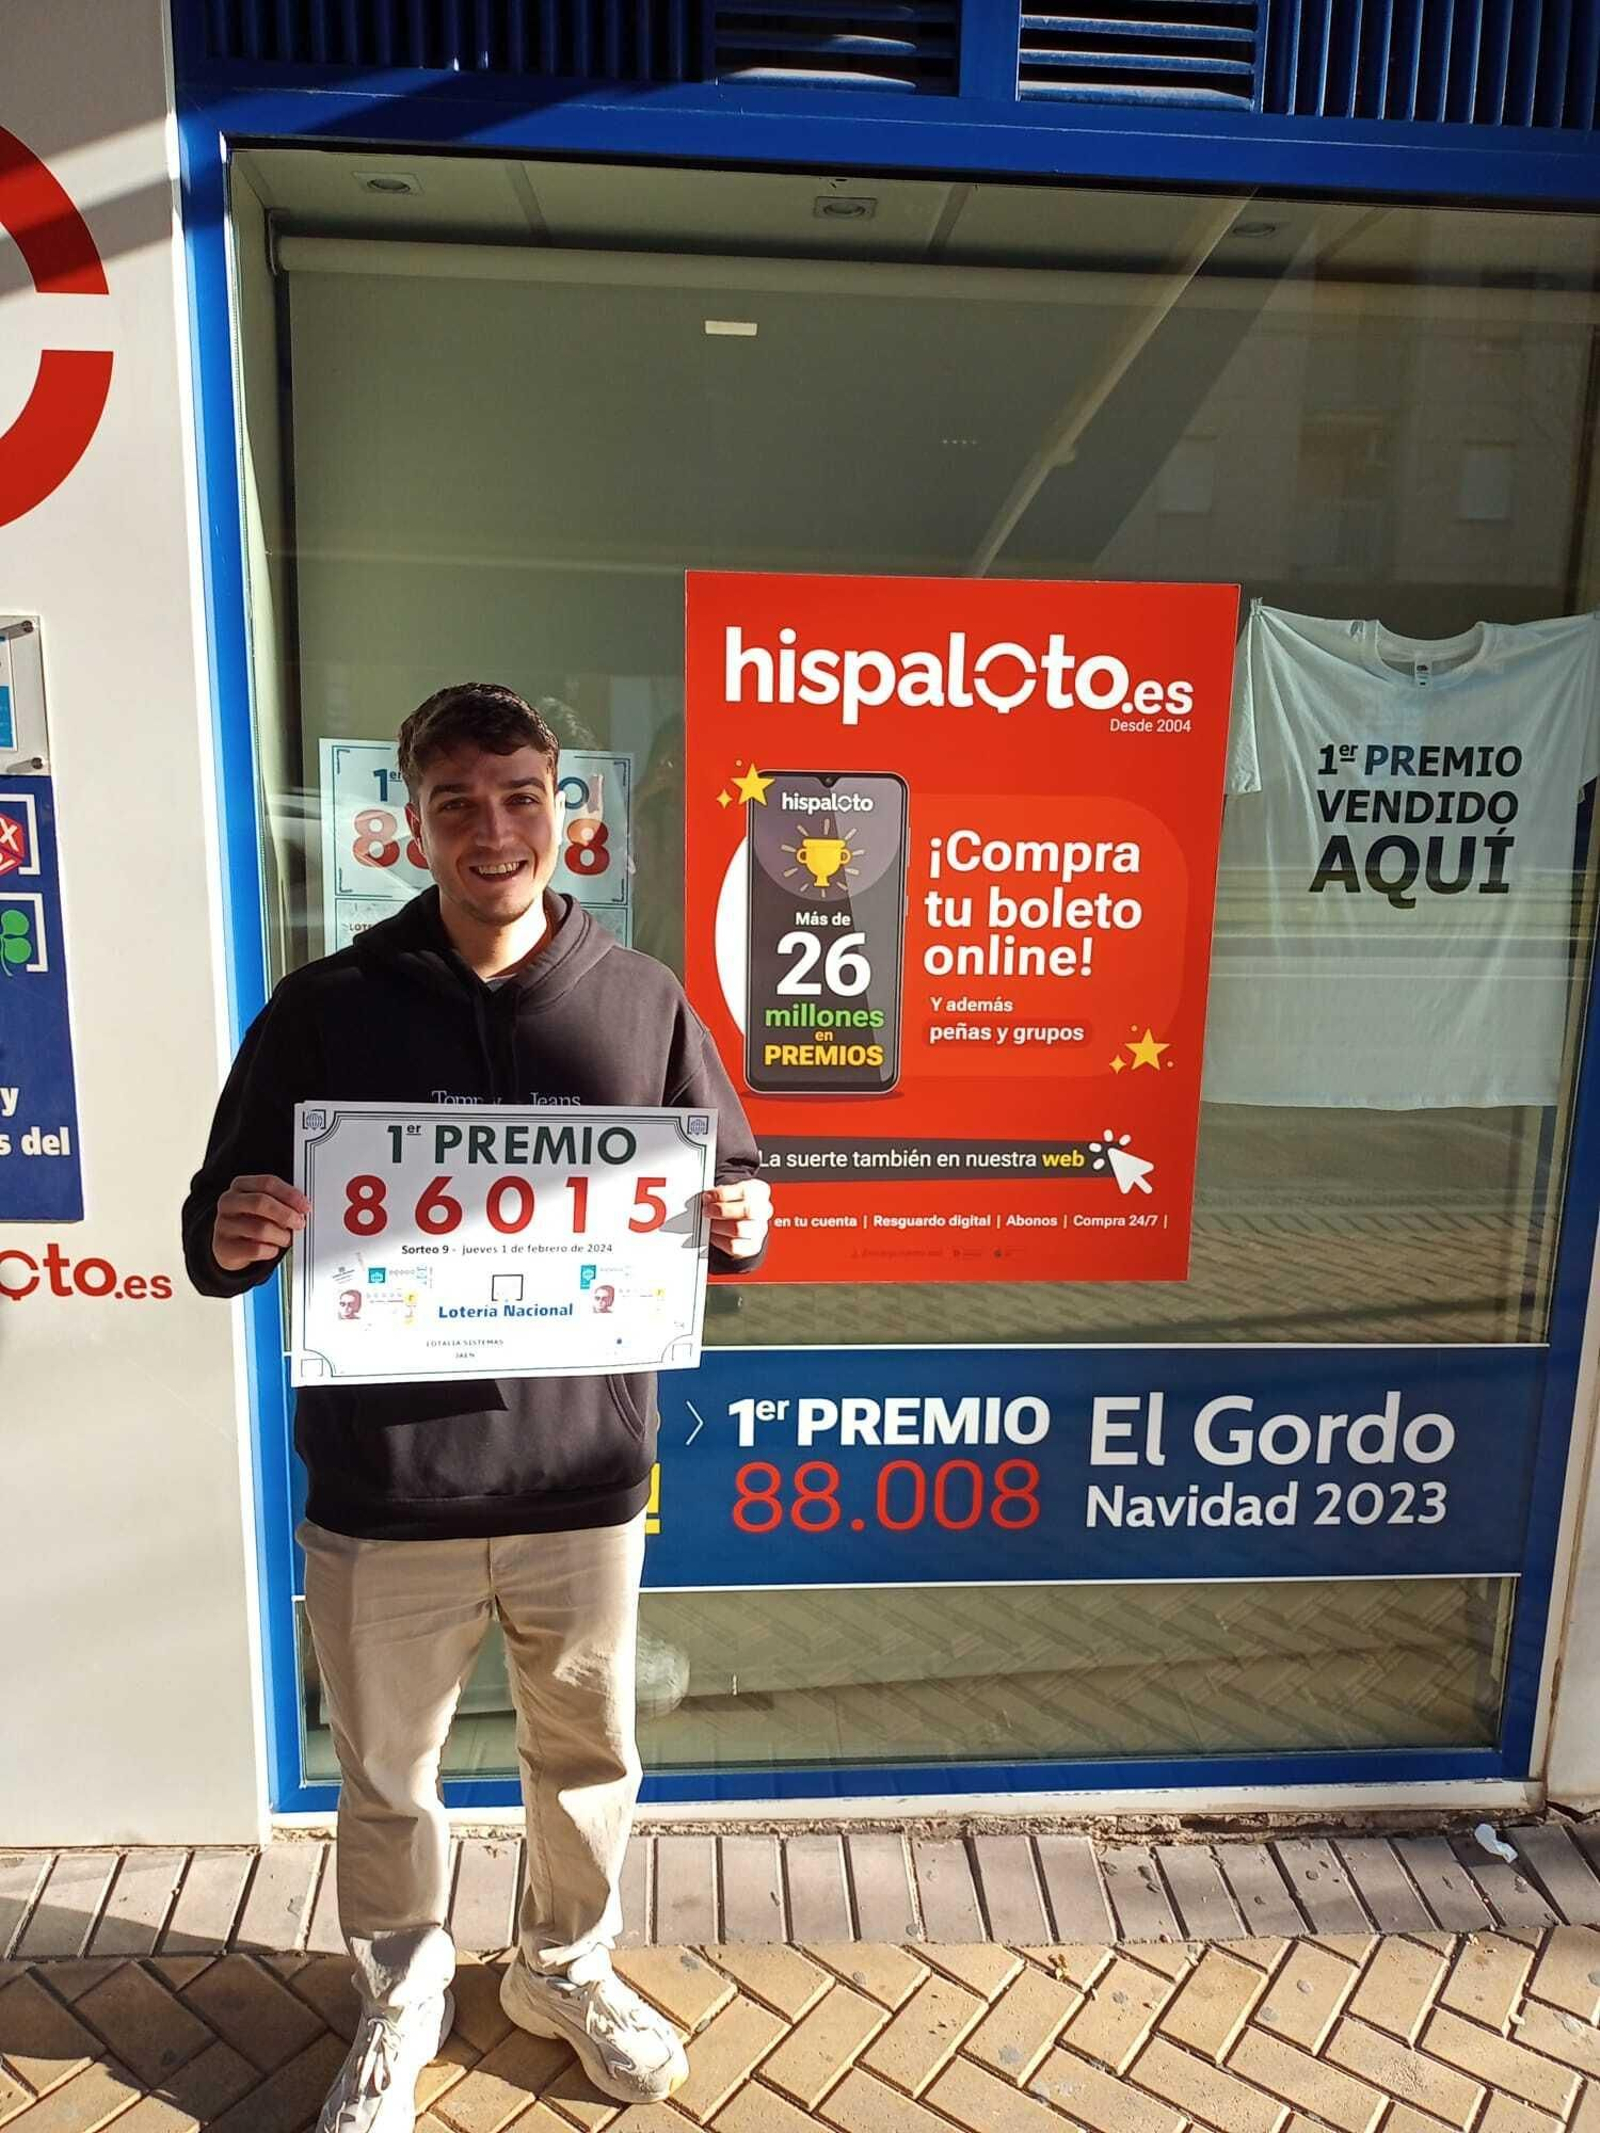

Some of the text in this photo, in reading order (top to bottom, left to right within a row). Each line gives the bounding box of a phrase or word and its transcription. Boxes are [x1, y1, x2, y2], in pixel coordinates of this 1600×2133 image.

[724, 626, 1194, 725] hispaloto.es
[1109, 718, 1191, 733] Desde 2004
[1317, 744, 1523, 777] 1er PREMIO
[781, 792, 873, 815] hispaloto
[1316, 789, 1519, 824] VENDIDO
[929, 829, 1141, 883] ¡Compra
[1308, 827, 1516, 910] AQUÍ
[795, 911, 851, 926] Más de
[924, 885, 1143, 929] tu boleto
[776, 930, 872, 998] 26
[923, 933, 1093, 977] online!
[765, 1003, 885, 1028] millones
[930, 996, 1014, 1012] Y además
[815, 1030, 833, 1042] en
[929, 1022, 1085, 1045] peñas y grupos
[764, 1044, 884, 1066] PREMIOS
[21, 1126, 71, 1156] del
[387, 1123, 637, 1165] 1er PREMIO
[759, 1149, 1085, 1168] La suerte también en nuestra web
[343, 1174, 668, 1236] 86015
[774, 1217, 790, 1227] en
[795, 1215, 808, 1227] tu
[811, 1215, 857, 1227] cuenta
[874, 1214, 946, 1229] Resguardo
[949, 1214, 991, 1229] digital
[1006, 1215, 1058, 1227] Abonos
[1073, 1215, 1126, 1228] Compra
[1129, 1215, 1158, 1227] 24/7
[401, 1245, 439, 1254] Sorteo
[442, 1245, 449, 1254] 9
[462, 1245, 498, 1256] jueves
[502, 1245, 507, 1253] 1
[511, 1244, 524, 1253] de
[527, 1244, 567, 1253] febrero
[571, 1244, 584, 1253] de
[587, 1243, 613, 1253] 2024
[503, 1303, 573, 1317] Nacional
[728, 1396, 1051, 1446] 1er PREMIO
[1090, 1391, 1455, 1466] El Gordo
[732, 1458, 1041, 1534] 88.008
[1086, 1481, 1447, 1528] Navidad 2023
